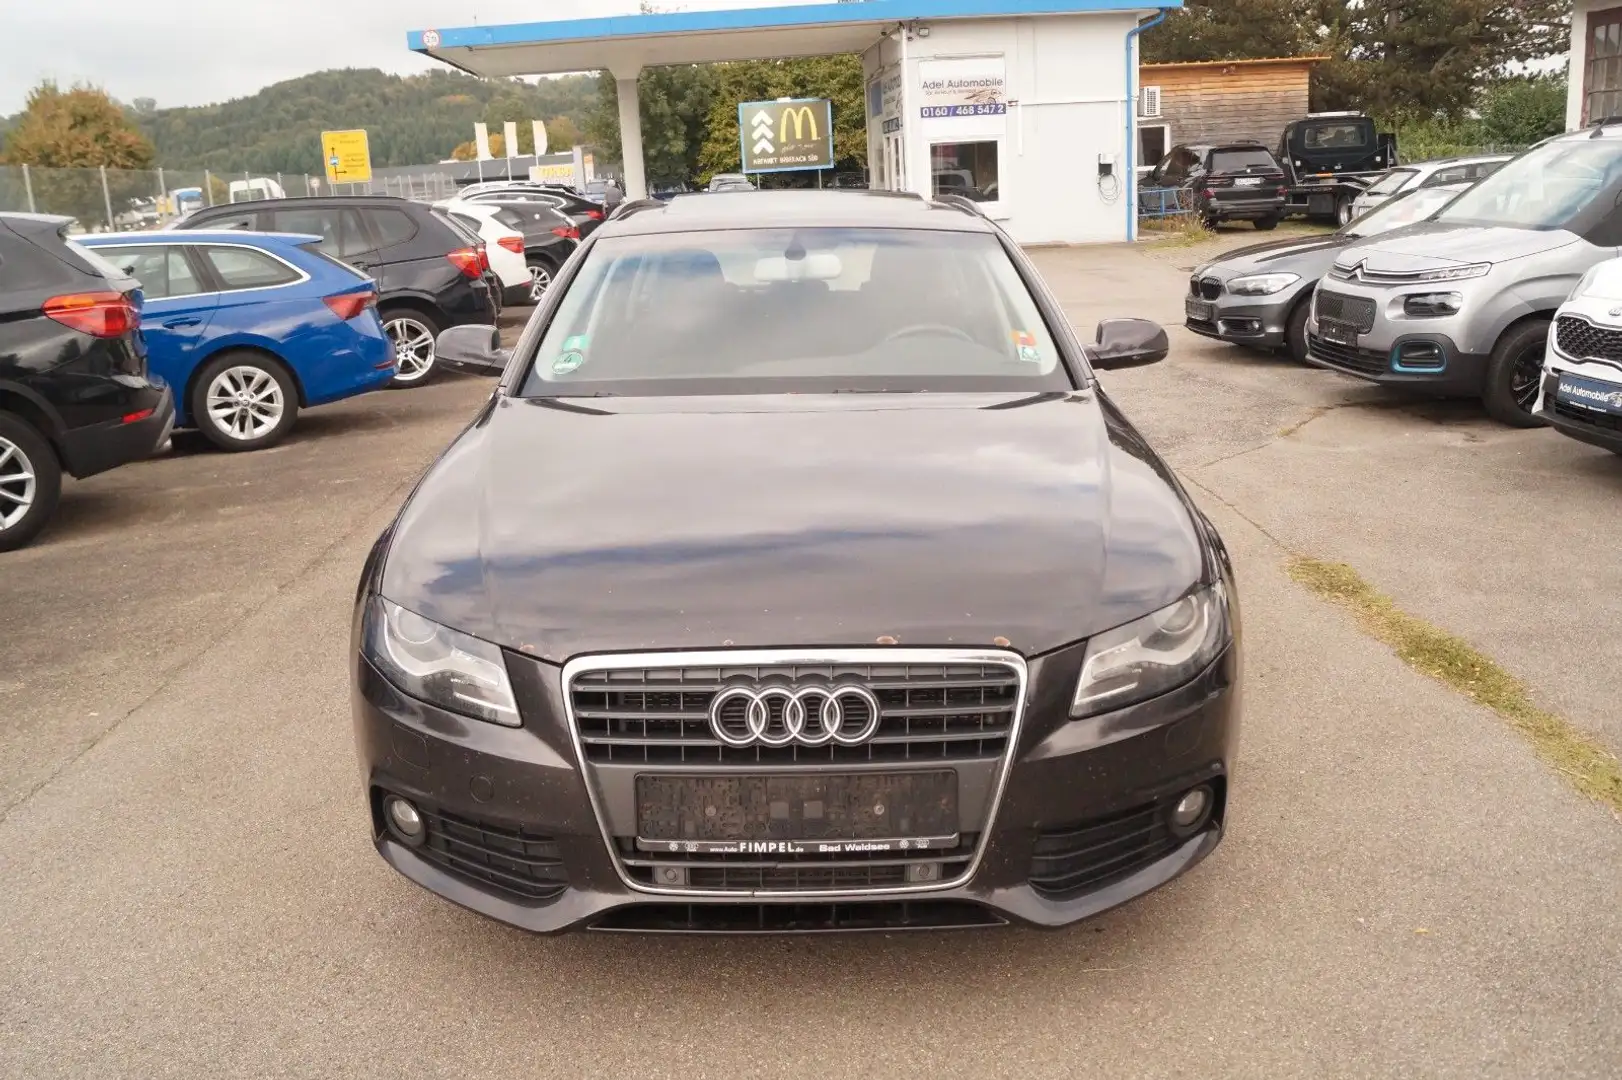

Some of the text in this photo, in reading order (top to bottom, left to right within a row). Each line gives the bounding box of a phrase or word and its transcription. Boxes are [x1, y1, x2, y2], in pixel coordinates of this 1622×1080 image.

[922, 78, 1003, 90] Adel Automobile
[922, 107, 948, 117] 0160
[956, 106, 975, 115] 468
[1559, 382, 1609, 402] Adel Automobile
[819, 844, 841, 852] Bad
[844, 843, 891, 851] Waldsee
